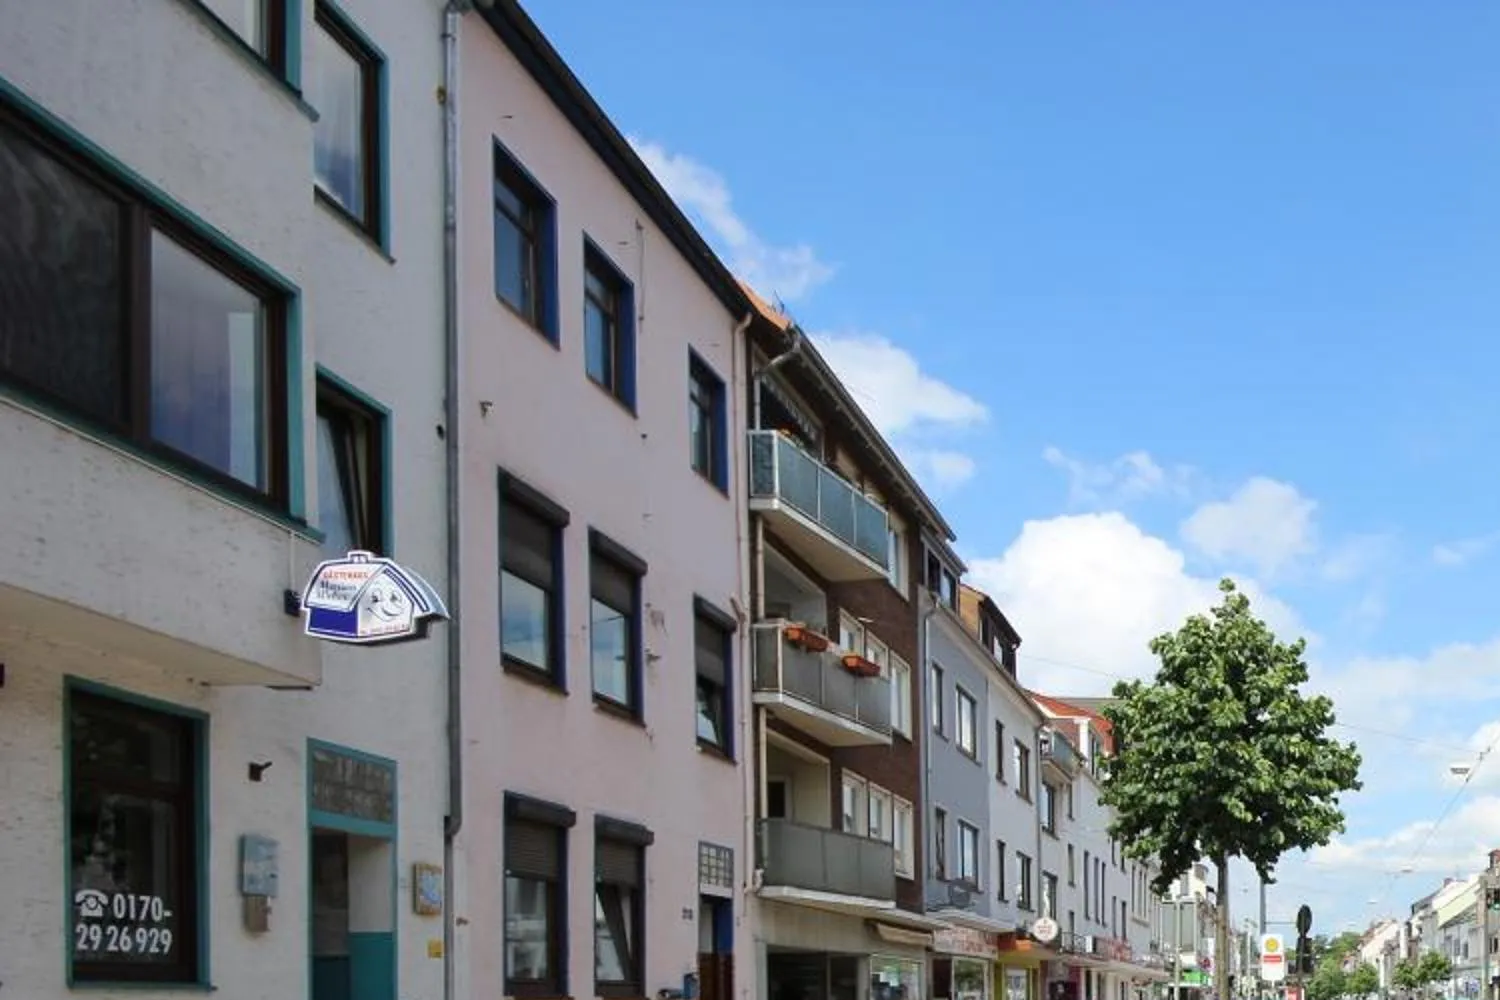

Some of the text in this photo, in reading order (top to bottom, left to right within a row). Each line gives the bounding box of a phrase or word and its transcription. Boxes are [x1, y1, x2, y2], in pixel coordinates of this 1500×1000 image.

[113, 893, 172, 921] 0170-
[76, 922, 172, 954] 29 26 929
